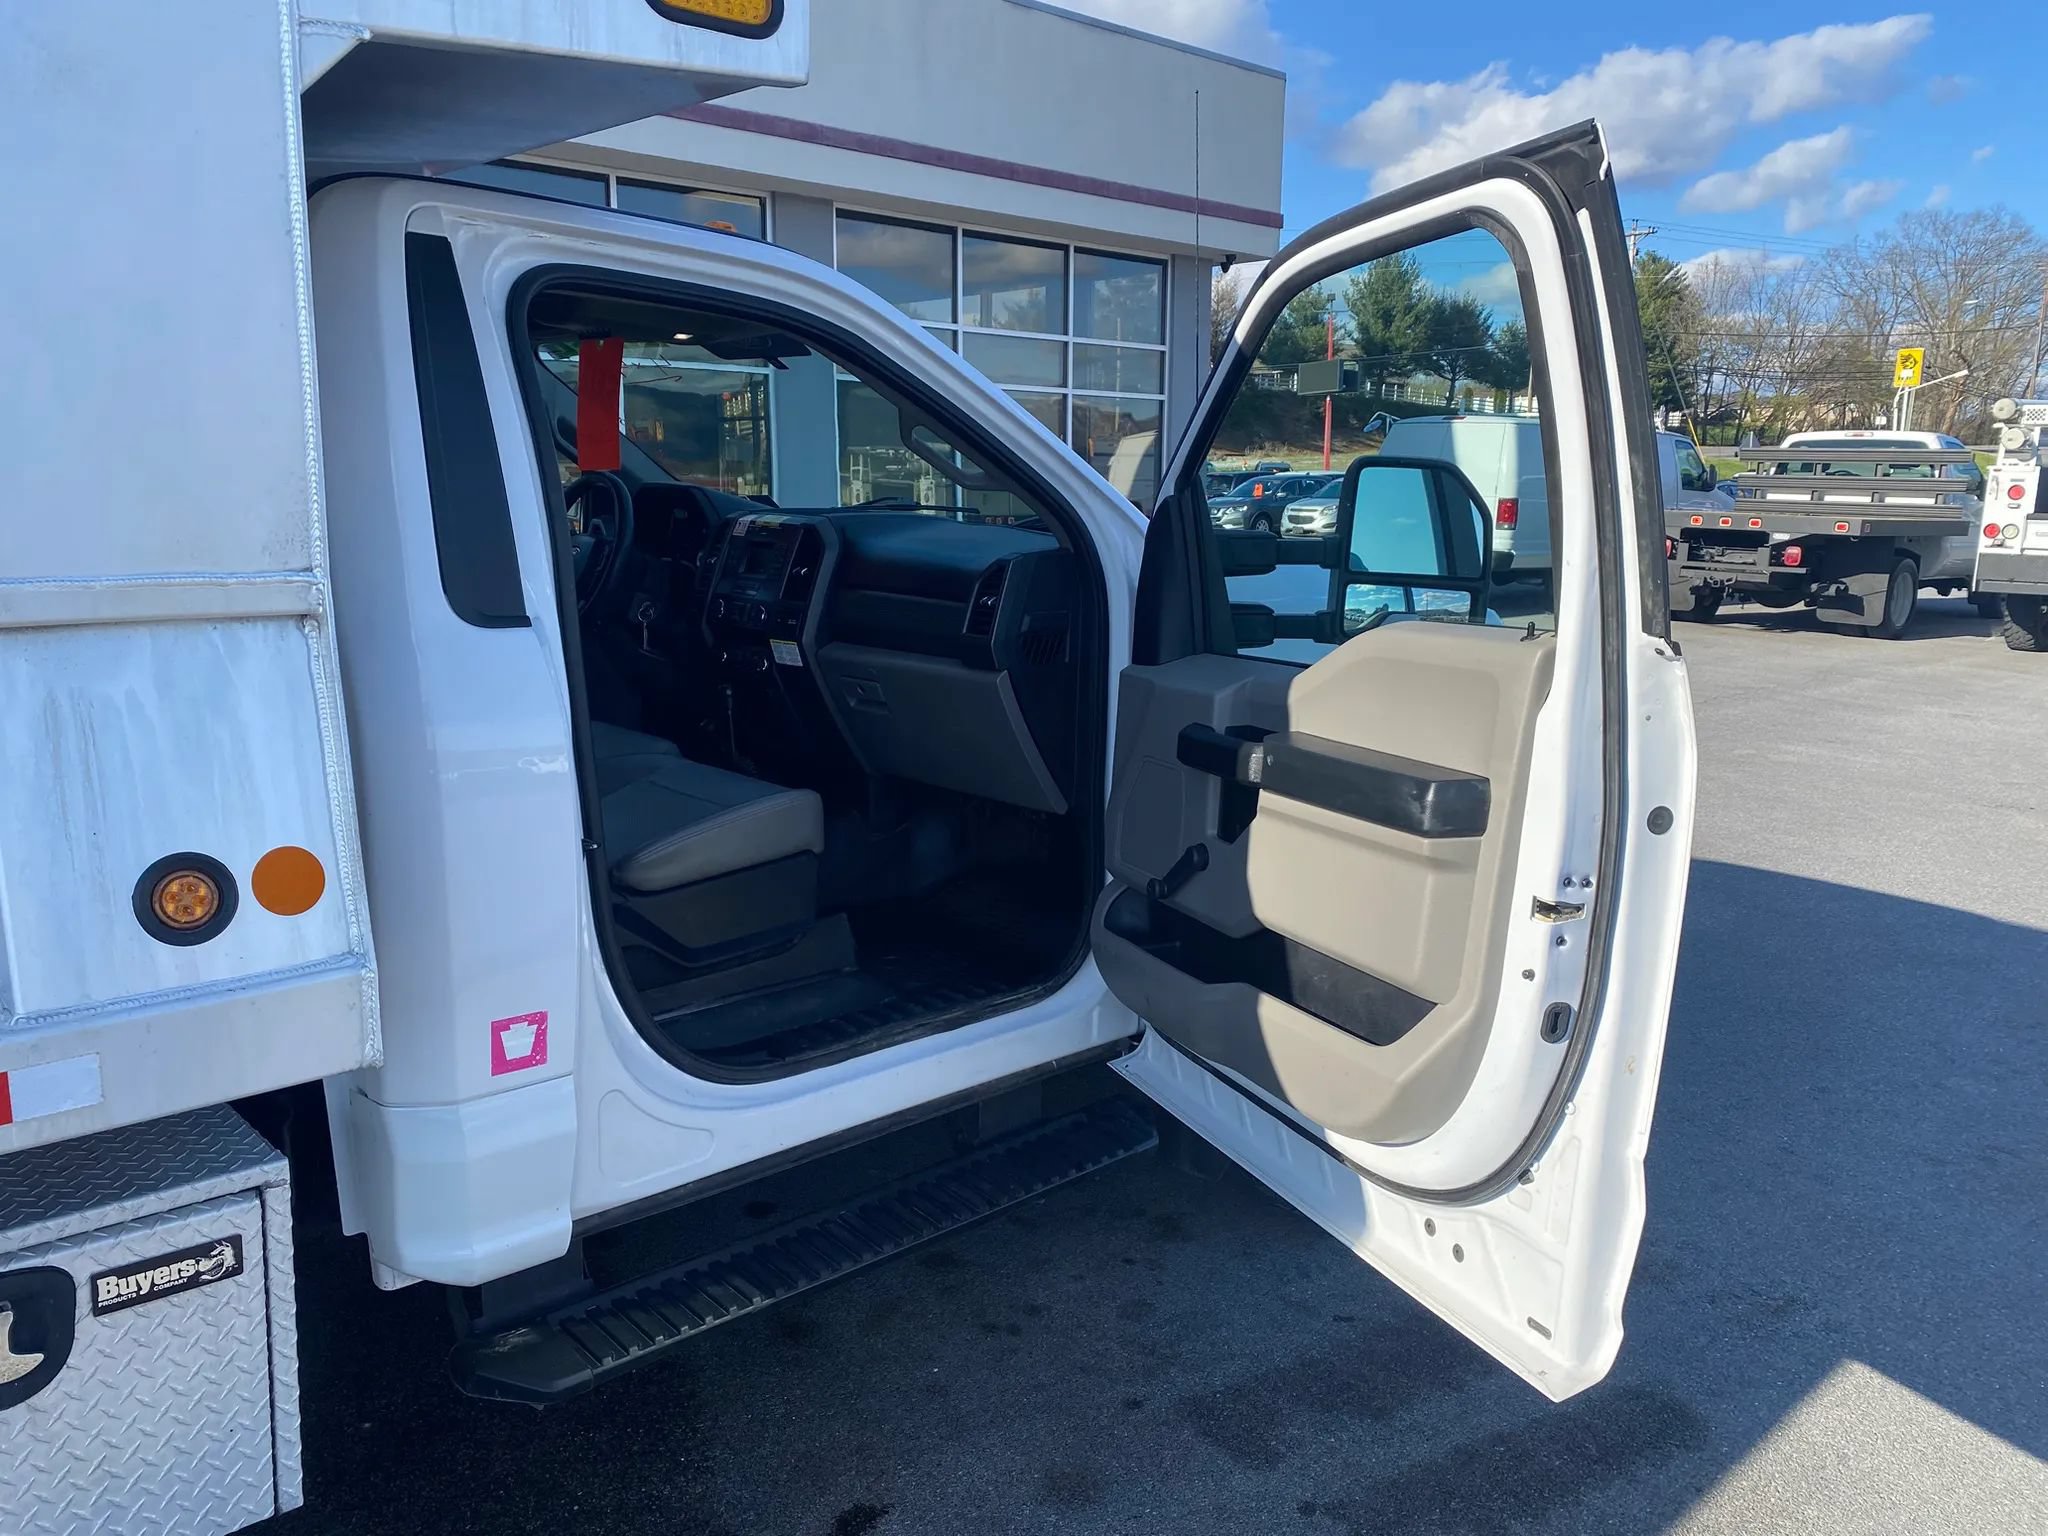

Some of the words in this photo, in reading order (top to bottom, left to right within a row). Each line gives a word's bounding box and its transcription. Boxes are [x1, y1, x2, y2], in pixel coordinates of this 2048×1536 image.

[96, 1258, 197, 1302] Buyers
[98, 1293, 137, 1308] PRODUCTS
[153, 1277, 189, 1292] COMPANY
